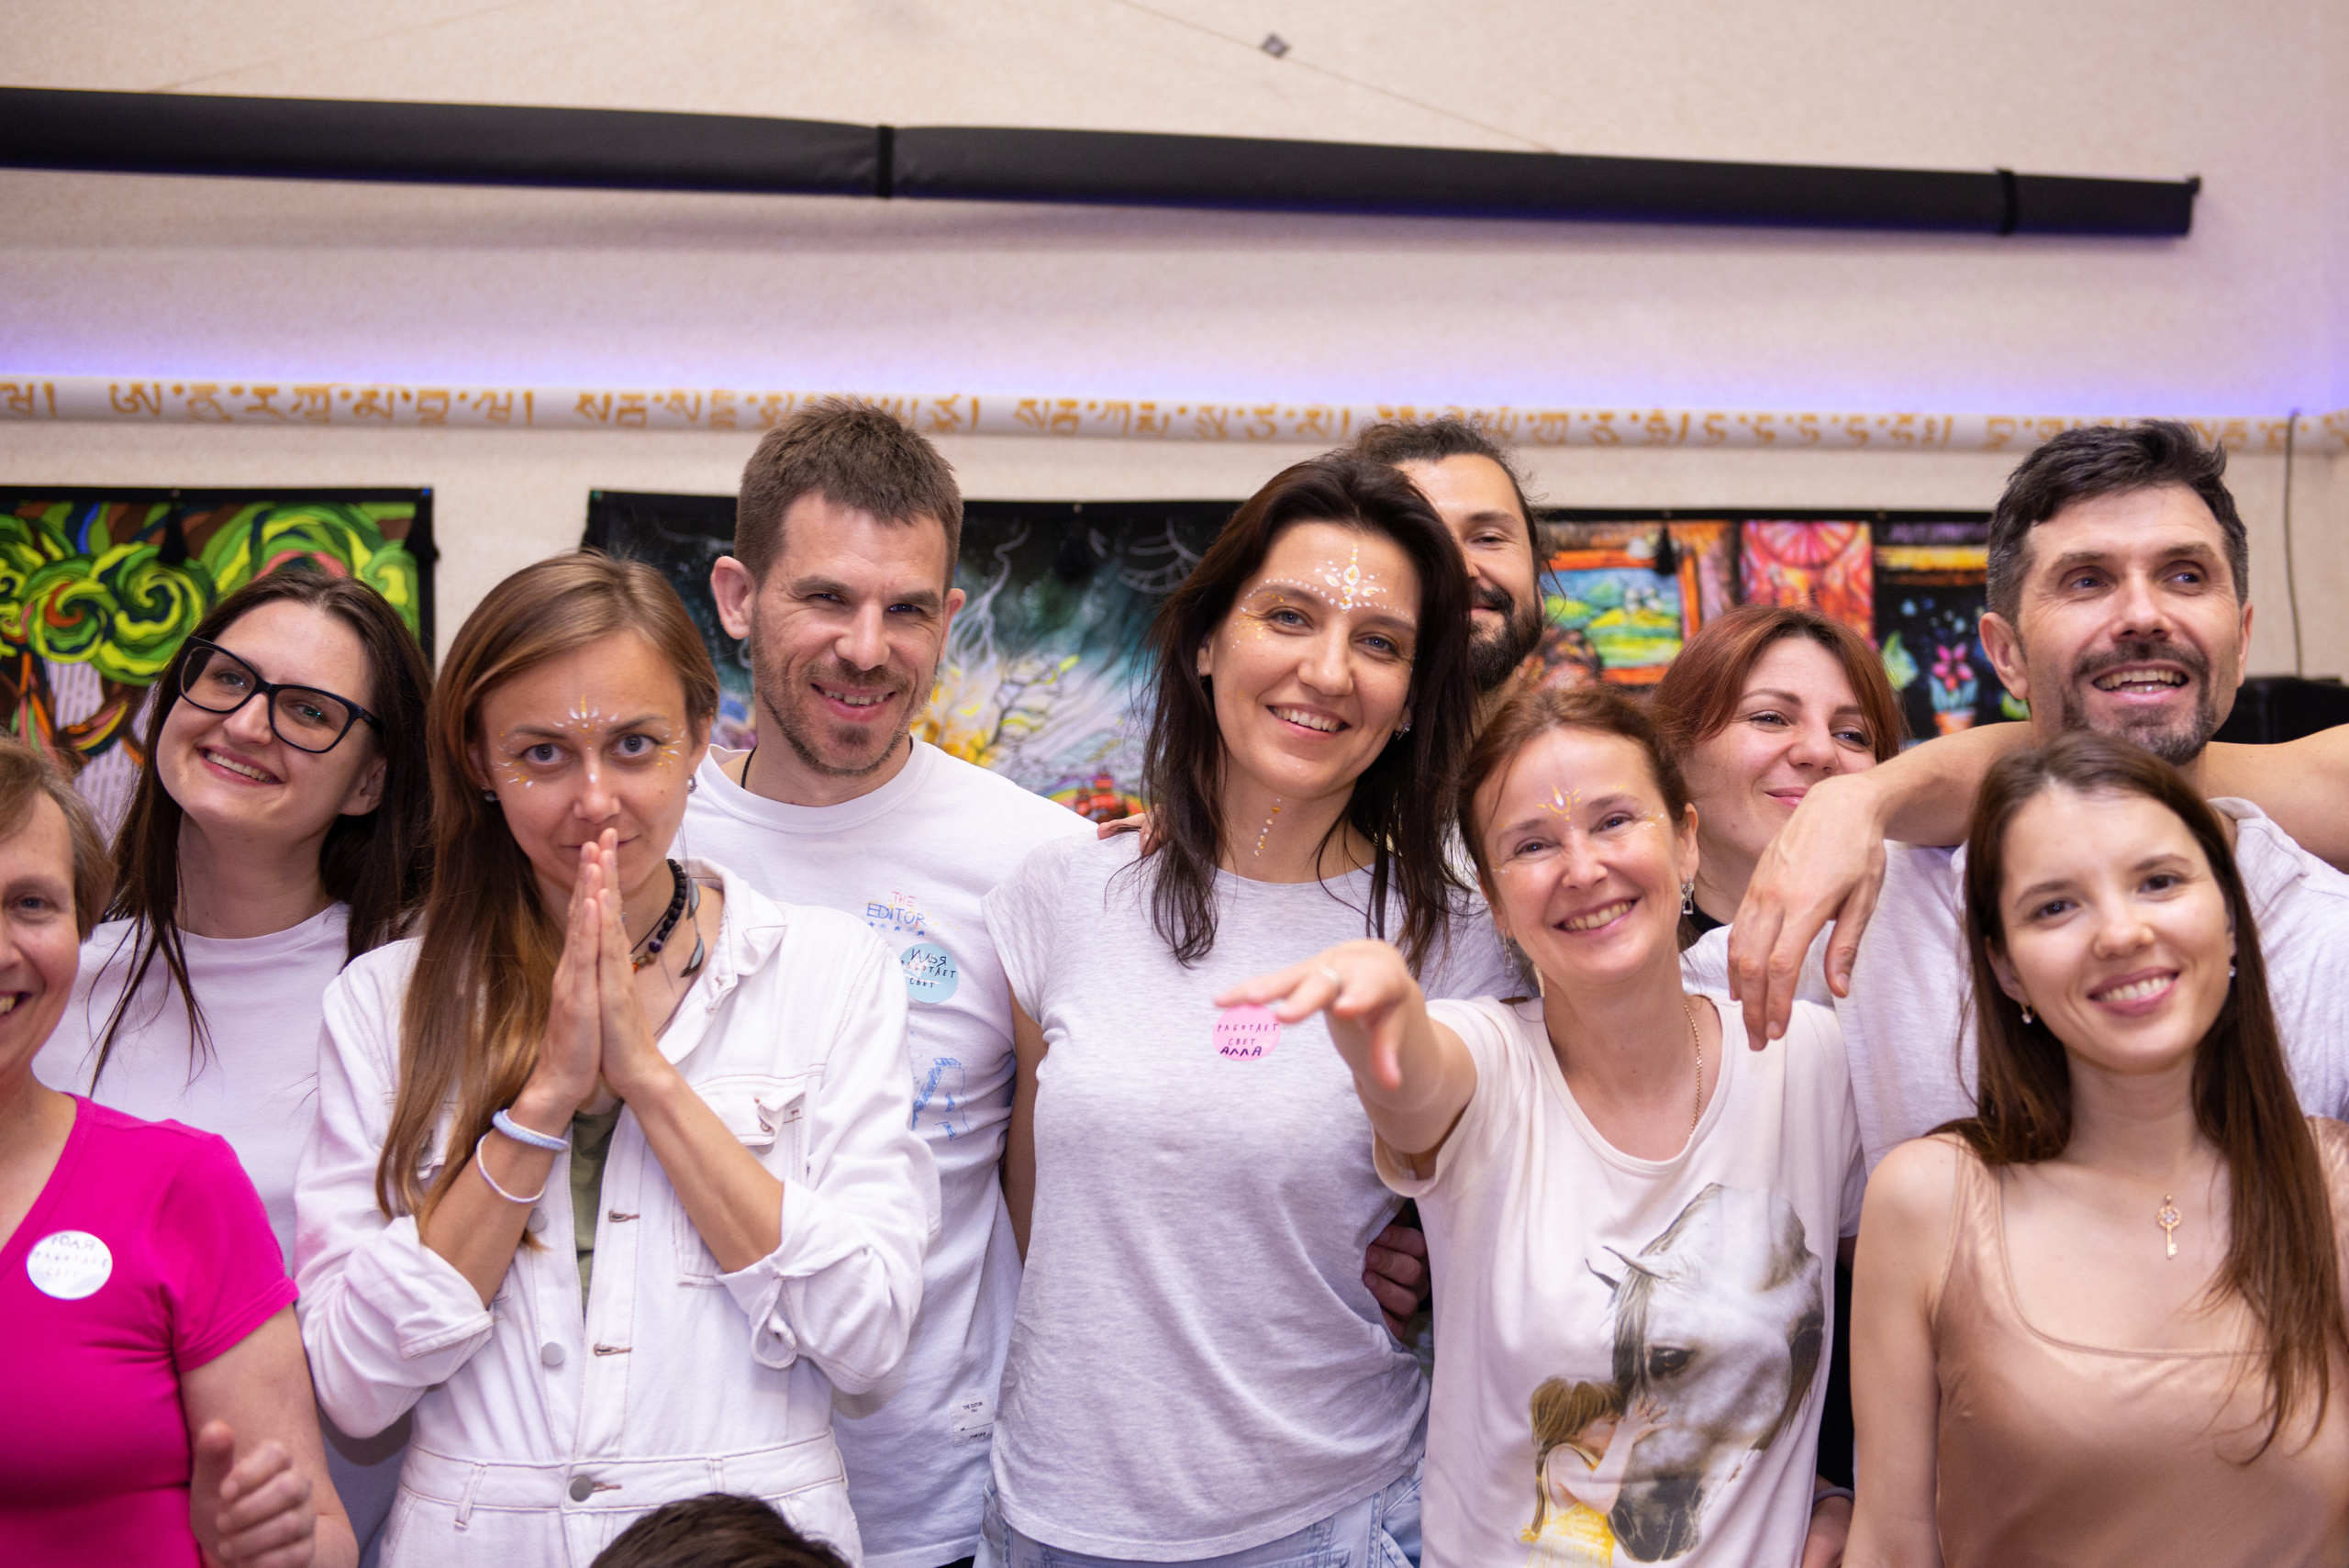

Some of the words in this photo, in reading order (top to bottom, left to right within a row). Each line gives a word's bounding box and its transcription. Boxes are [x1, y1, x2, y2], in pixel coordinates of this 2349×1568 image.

[891, 891, 917, 907] THE
[866, 903, 927, 927] EDITOR
[909, 977, 935, 988] СВЕТ
[1217, 1023, 1279, 1033] РАБОТАЕТ
[1228, 1038, 1256, 1046] СВЕТ
[1219, 1045, 1263, 1057] АЛЛА
